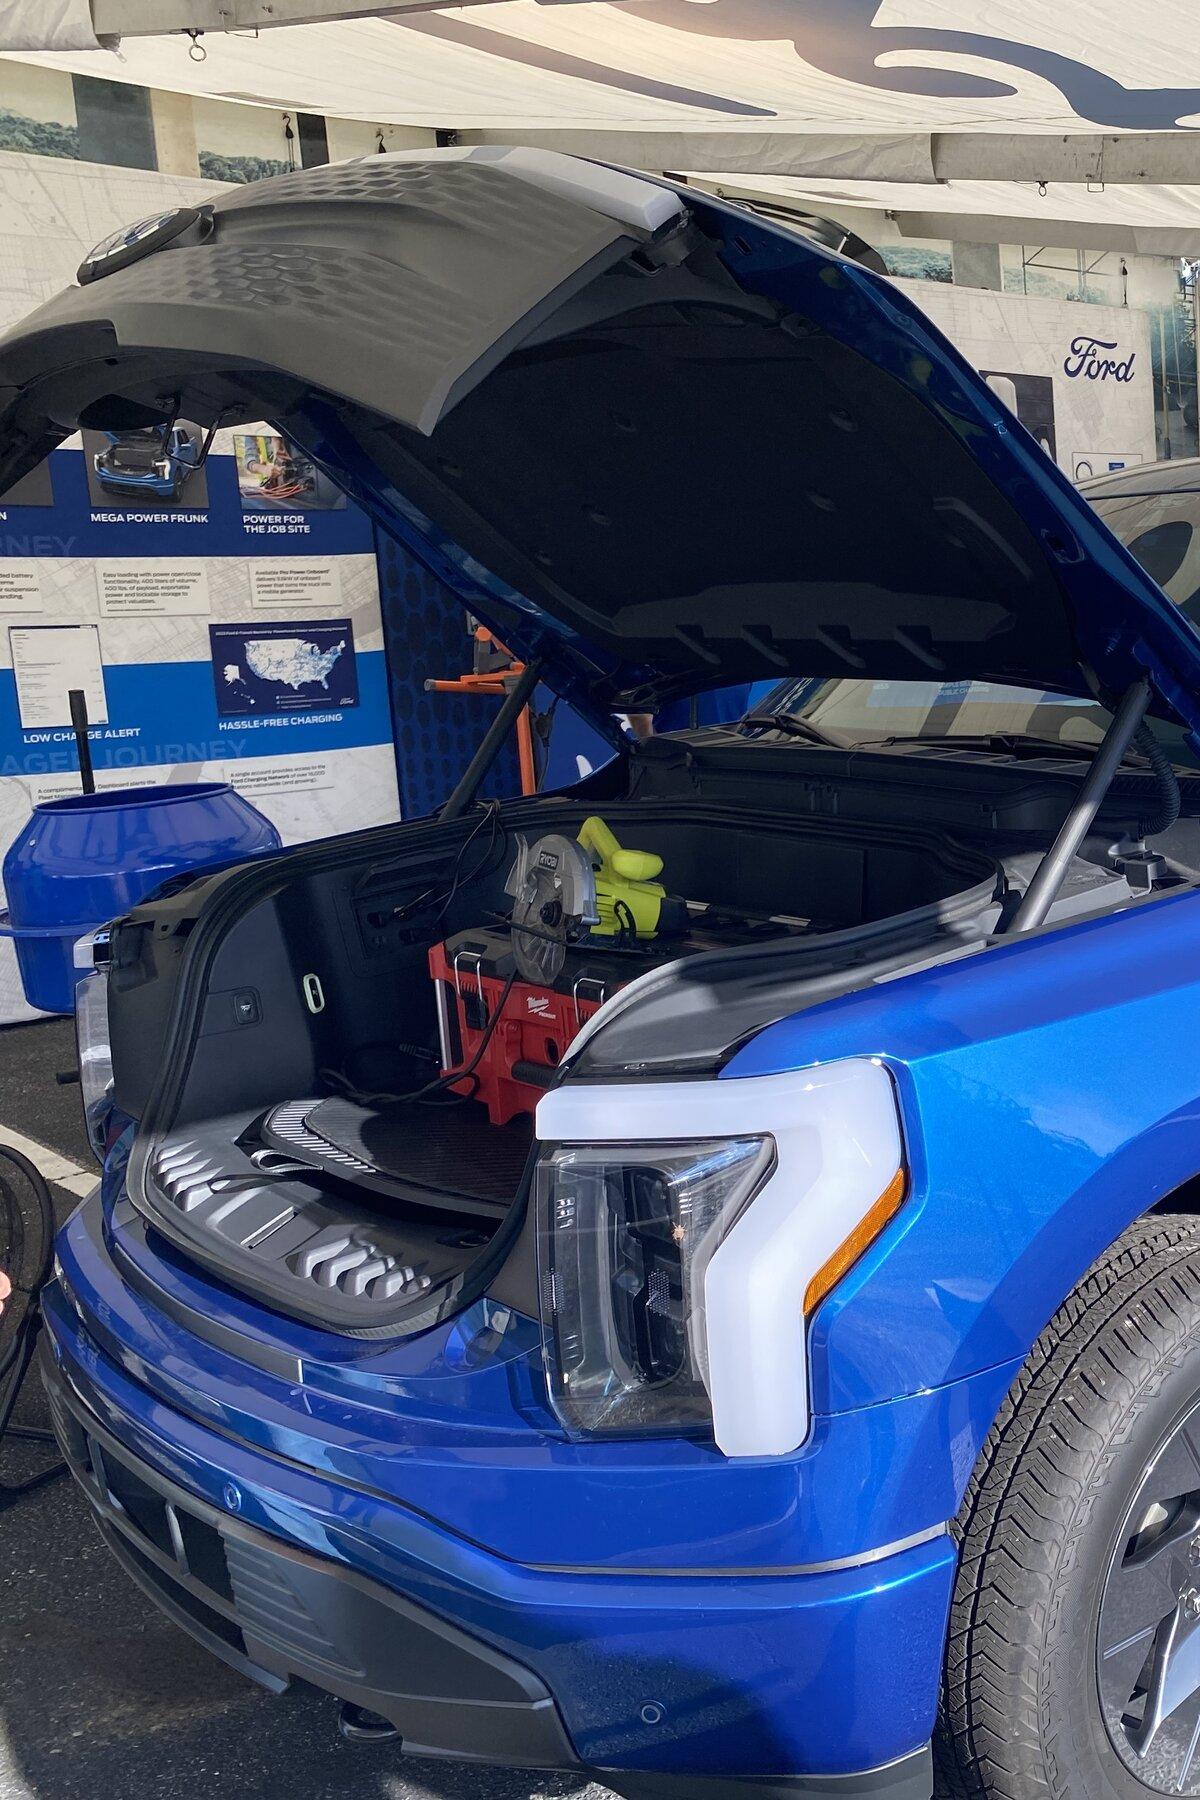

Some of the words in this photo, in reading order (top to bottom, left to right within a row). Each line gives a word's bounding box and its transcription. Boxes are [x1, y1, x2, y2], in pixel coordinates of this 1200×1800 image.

[1064, 336, 1136, 382] Ford
[90, 513, 125, 523] MEGA
[127, 513, 169, 523] POWER
[170, 514, 209, 523] FRUNK
[242, 515, 282, 524] POWER
[283, 515, 305, 524] FOR
[243, 524, 266, 534] THE
[266, 524, 287, 534] JOB
[288, 524, 311, 534] SITE
[218, 716, 290, 731] HASSLE-FREE
[290, 713, 343, 725] CHARGING
[23, 733, 51, 744] LOW
[53, 730, 102, 741] CHAGE
[104, 727, 142, 739] ALERT
[539, 853, 558, 867] RYOBI
